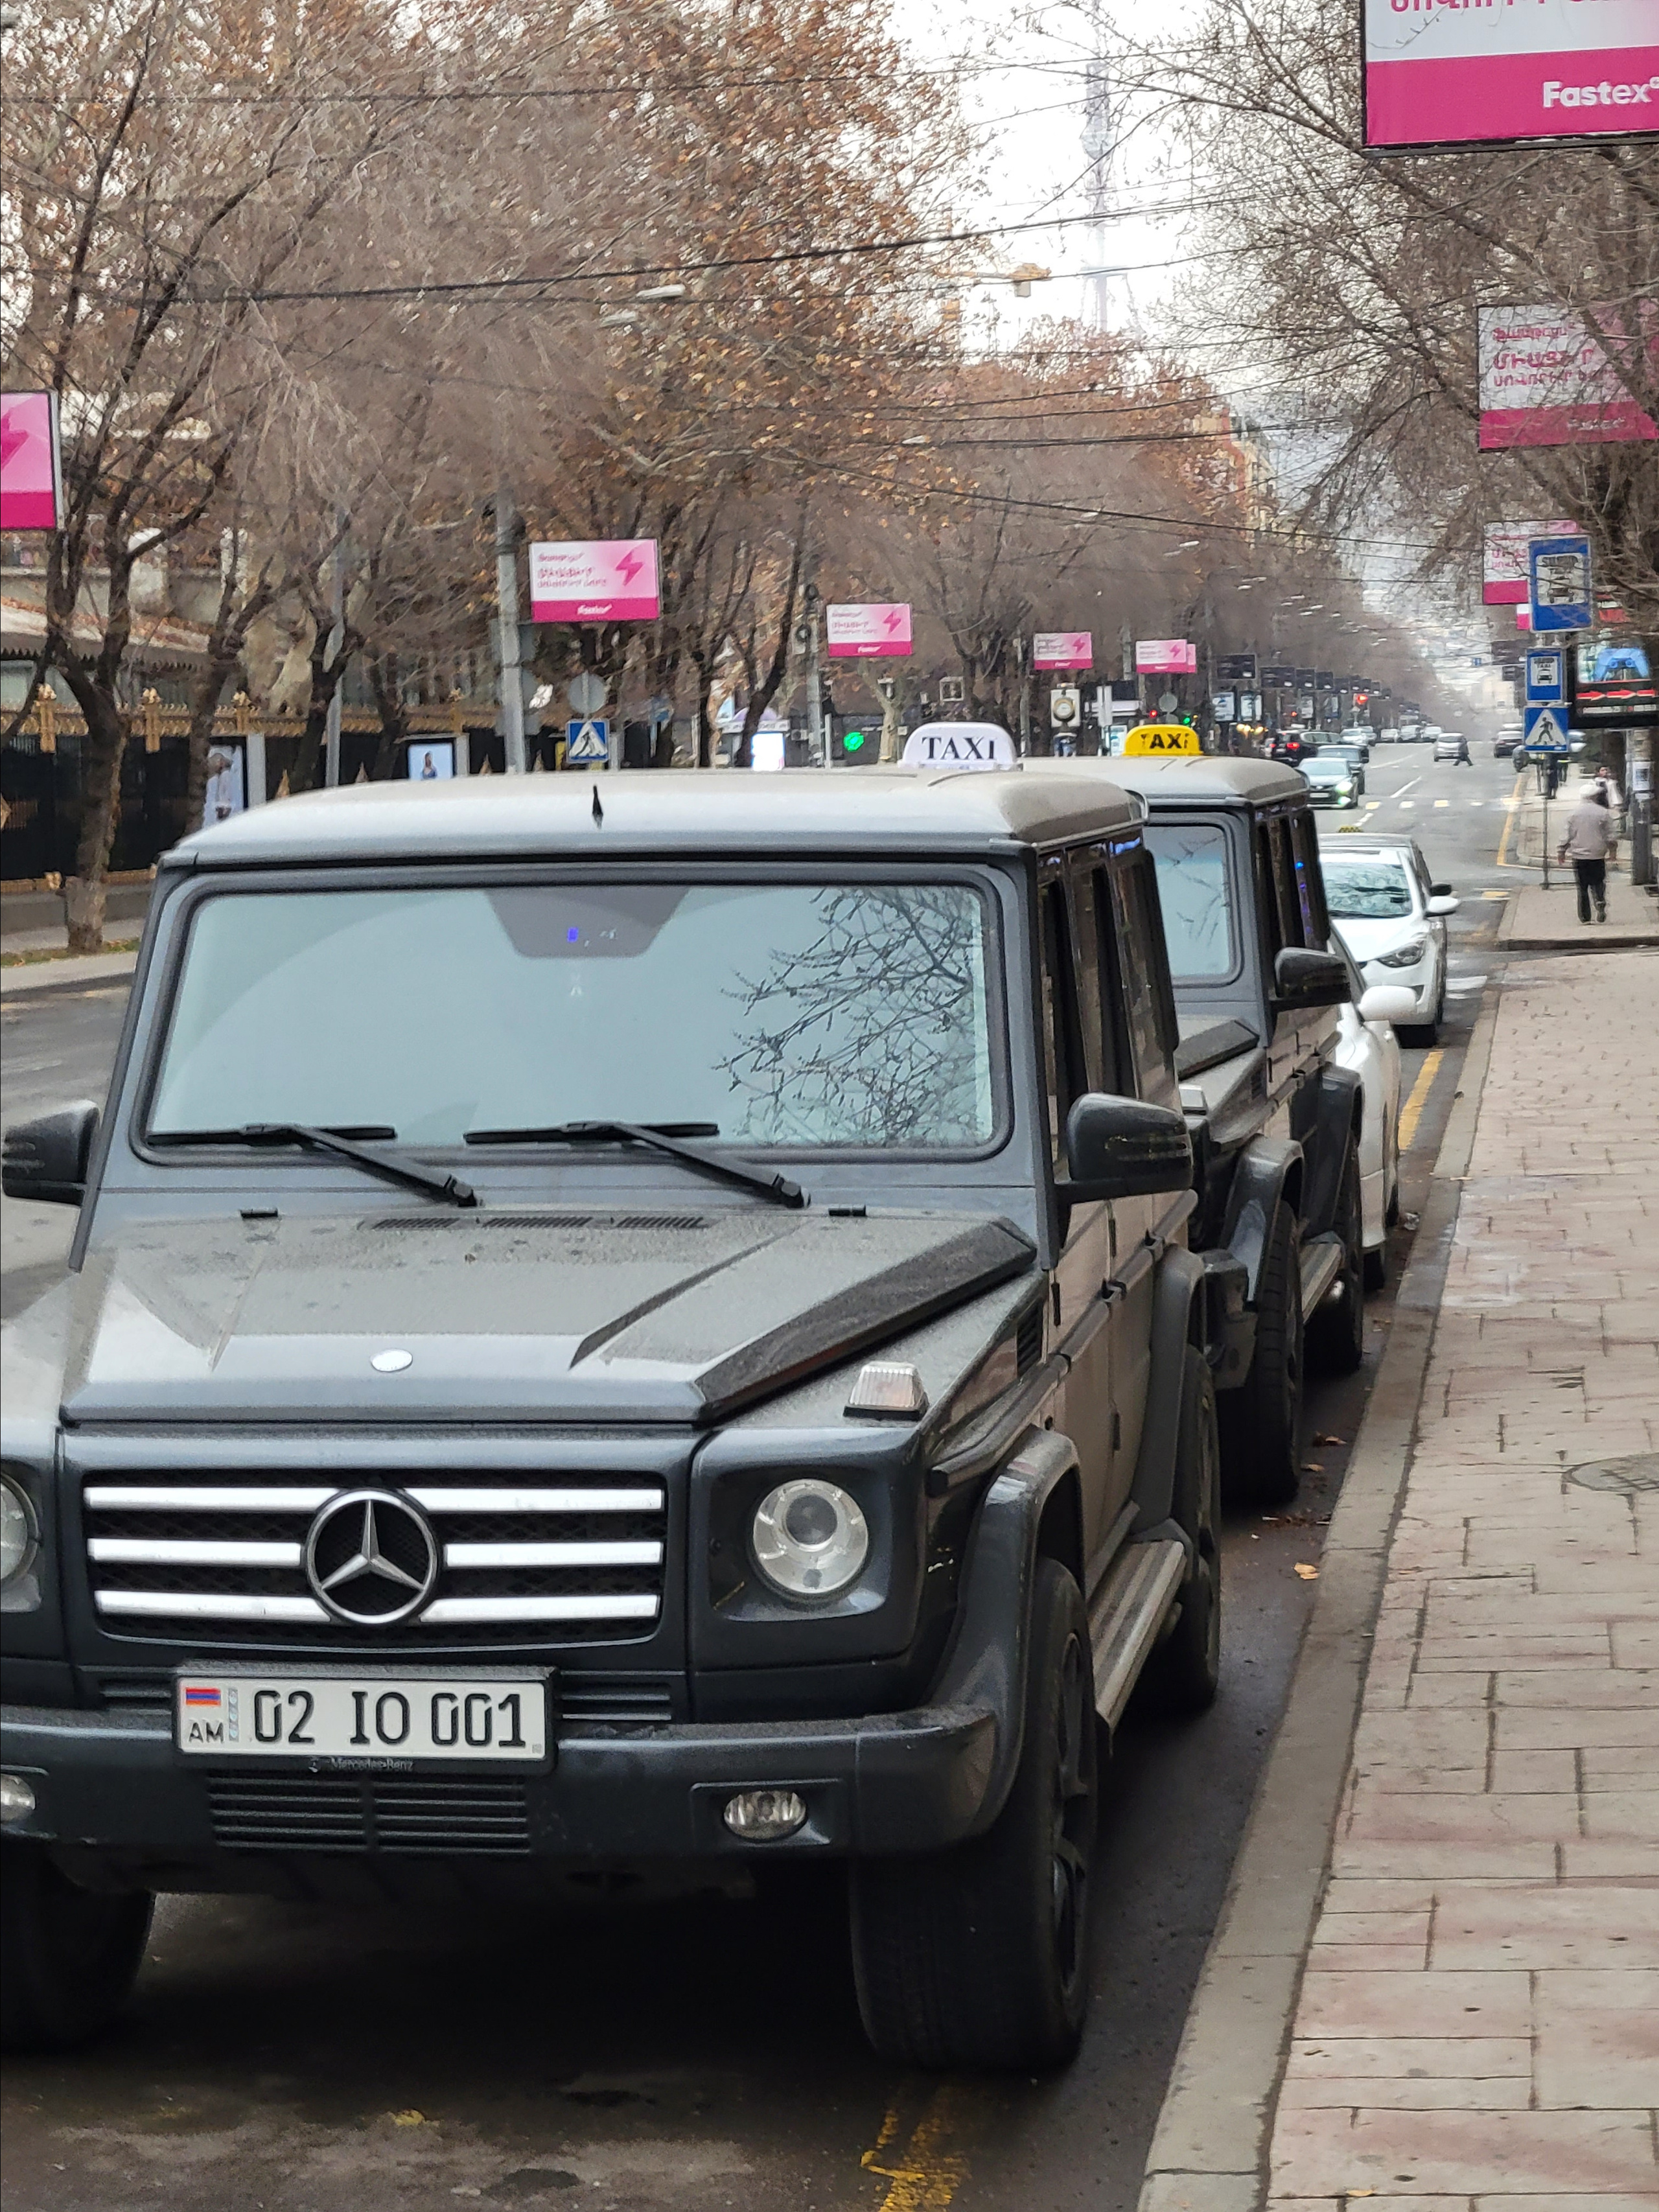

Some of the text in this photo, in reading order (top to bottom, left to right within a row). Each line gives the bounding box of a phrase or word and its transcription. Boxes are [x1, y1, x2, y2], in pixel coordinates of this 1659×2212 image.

[1543, 81, 1653, 108] Fastex
[921, 736, 998, 760] TAXI
[254, 1690, 315, 1743] 02
[431, 1692, 526, 1748] 001
[189, 1721, 225, 1743] AM
